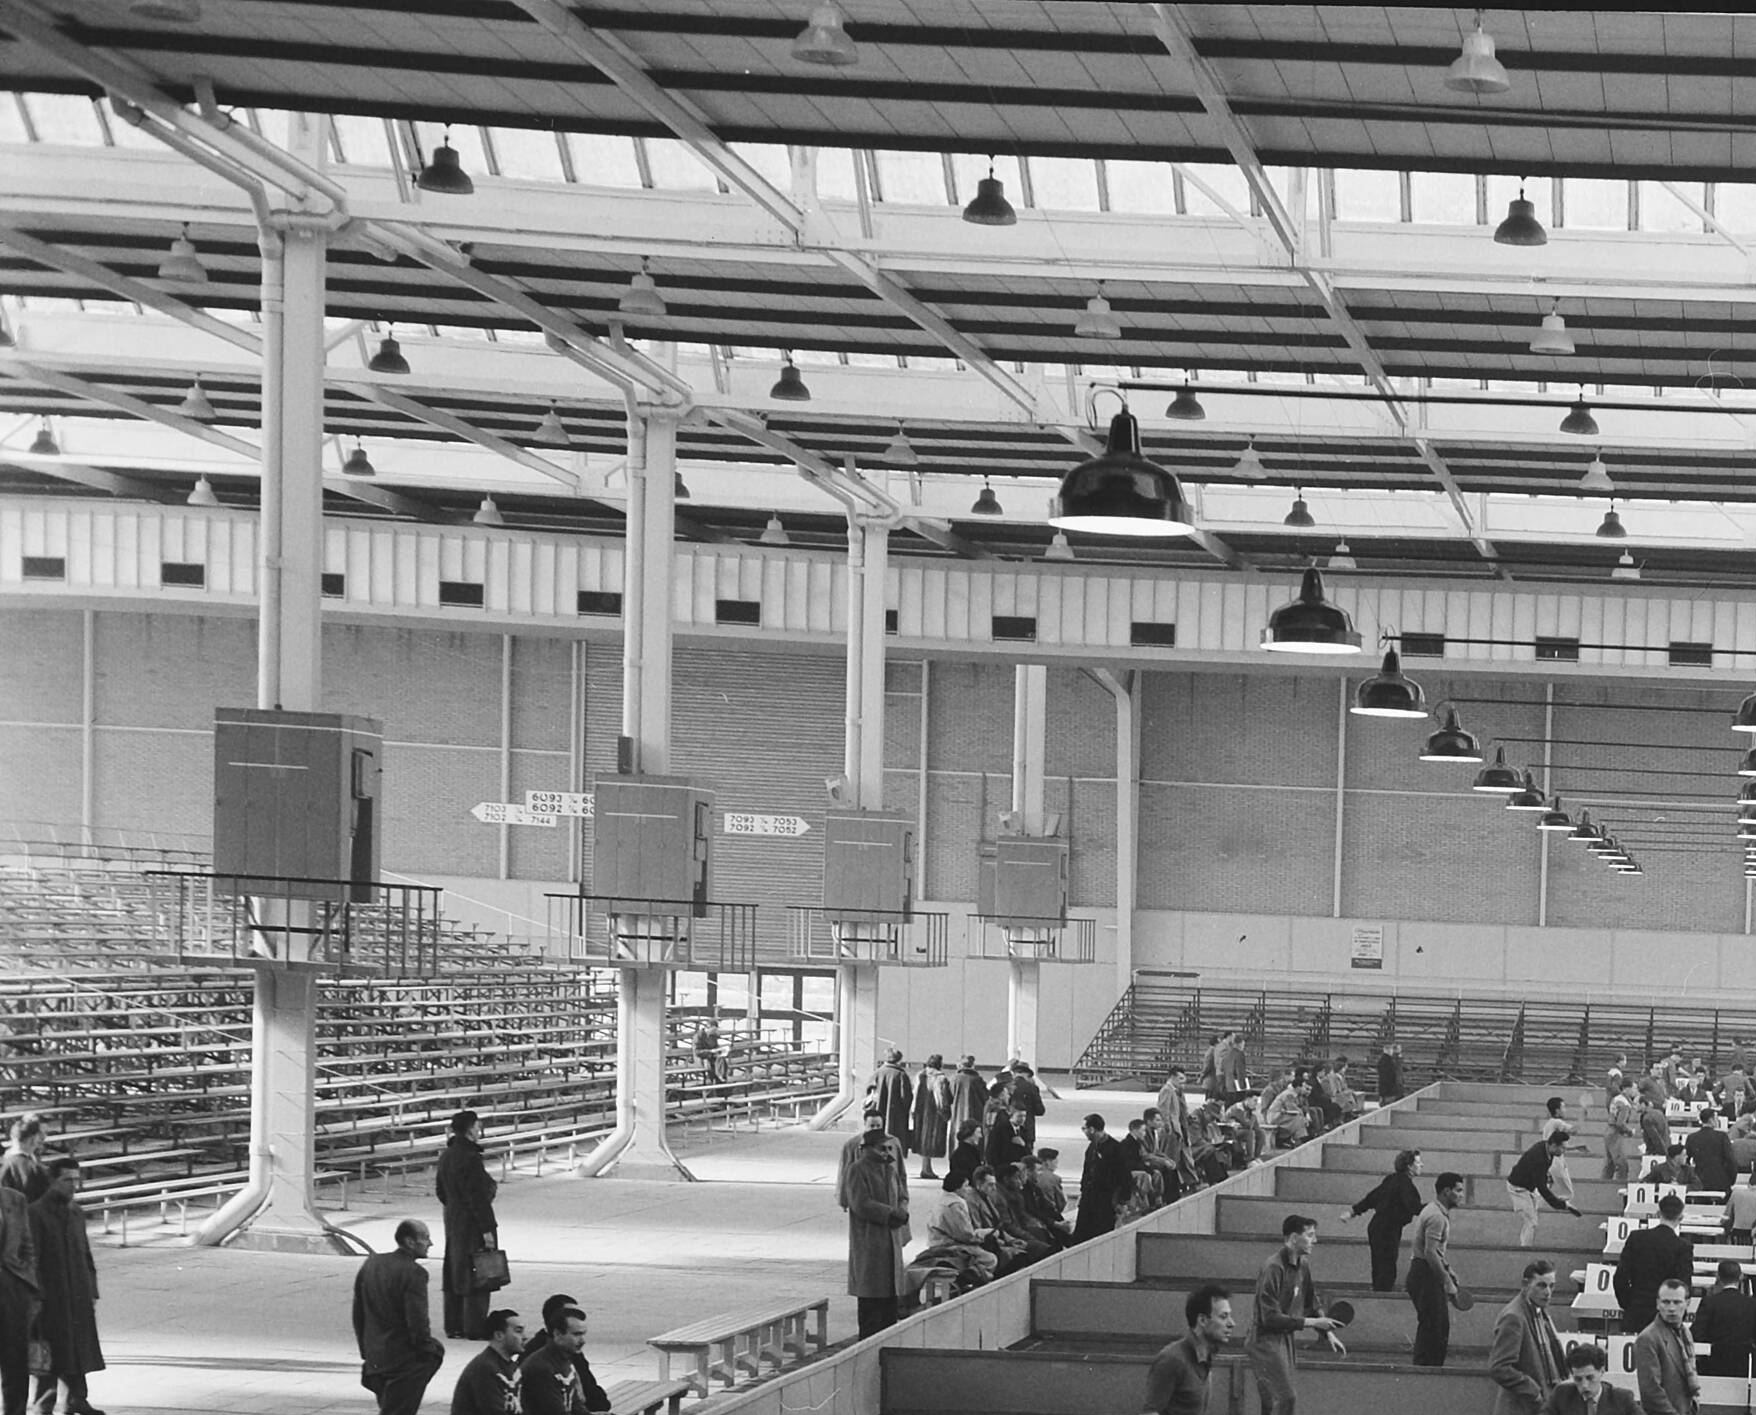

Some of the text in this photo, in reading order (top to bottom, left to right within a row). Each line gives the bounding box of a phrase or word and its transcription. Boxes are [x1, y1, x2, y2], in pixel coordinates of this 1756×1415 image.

[532, 793, 562, 803] 6093
[532, 803, 562, 814] 6092
[1618, 1222, 1628, 1240] 0
[1598, 1269, 1610, 1291] 0
